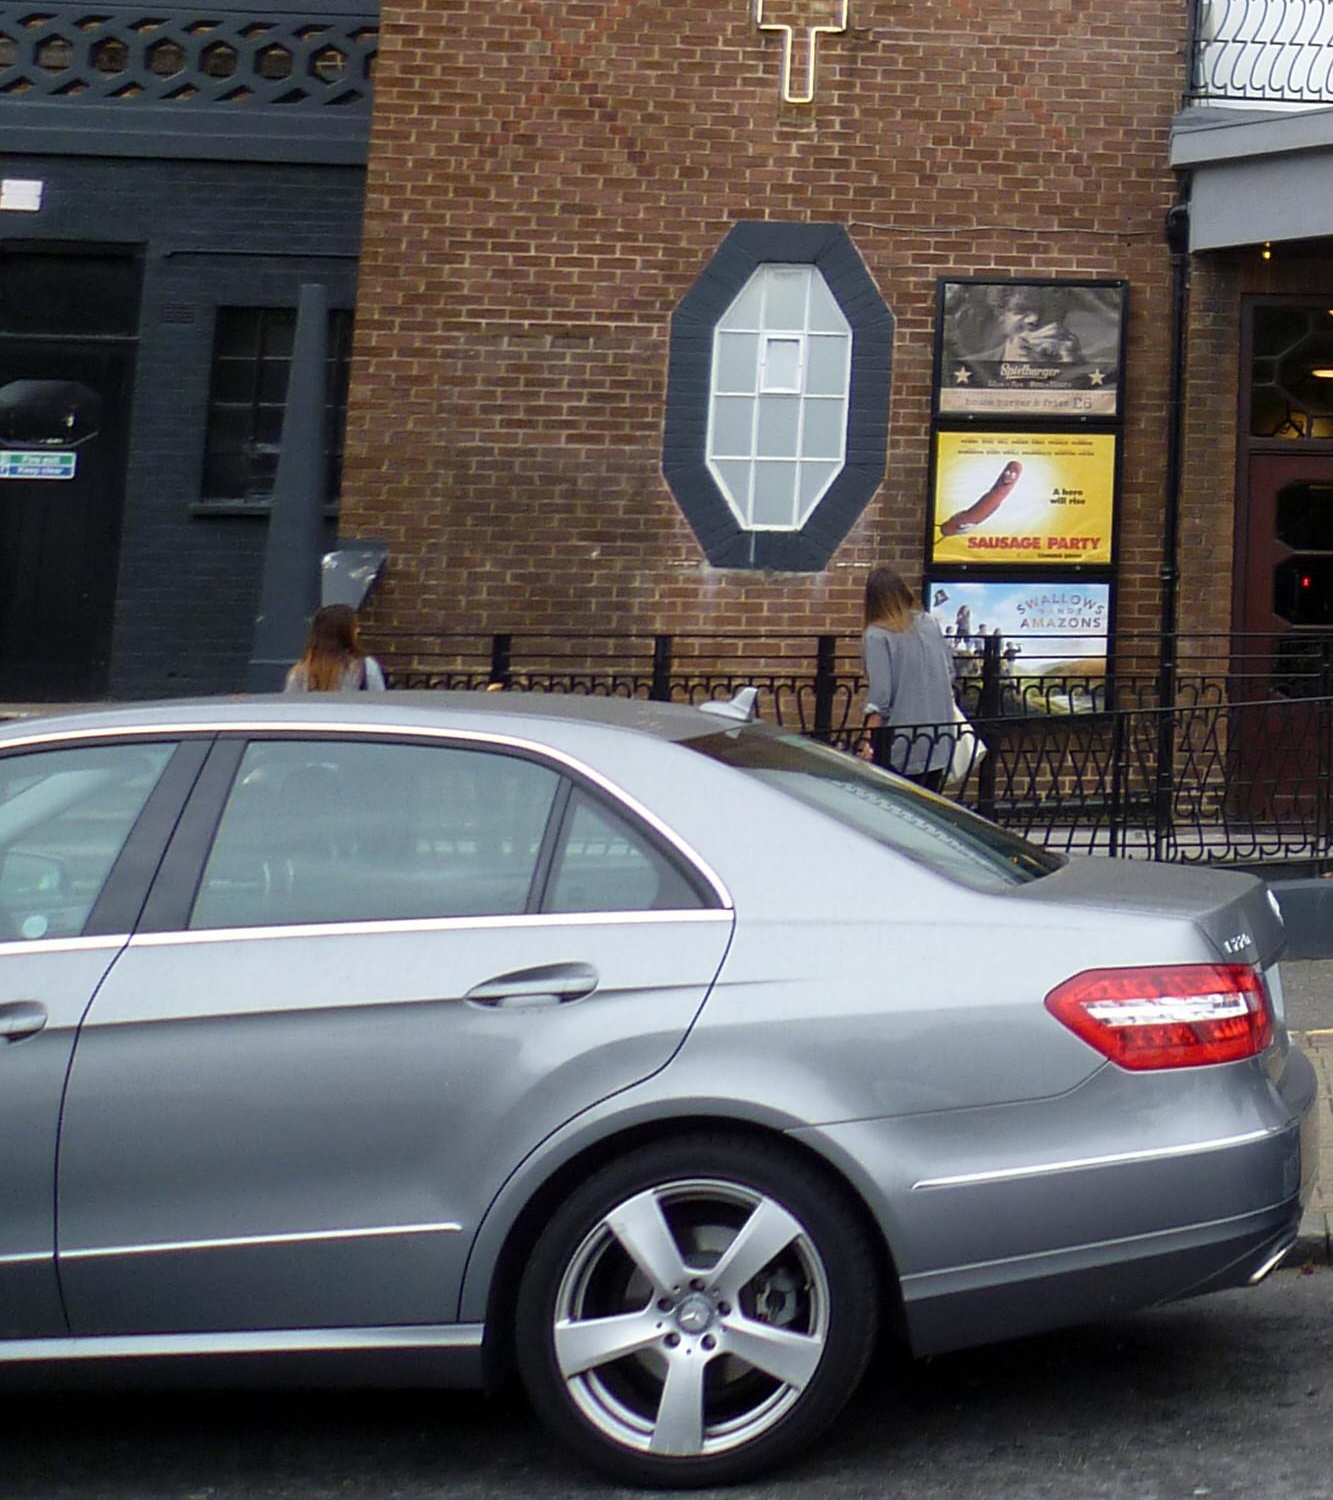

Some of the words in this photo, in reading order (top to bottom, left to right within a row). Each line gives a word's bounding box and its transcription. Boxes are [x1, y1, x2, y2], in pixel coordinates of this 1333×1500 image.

[967, 536, 1041, 550] SAUSAGE
[1047, 536, 1101, 551] PARTY
[1016, 593, 1105, 615] SWALLOWS
[1020, 617, 1102, 629] AMAZONS
